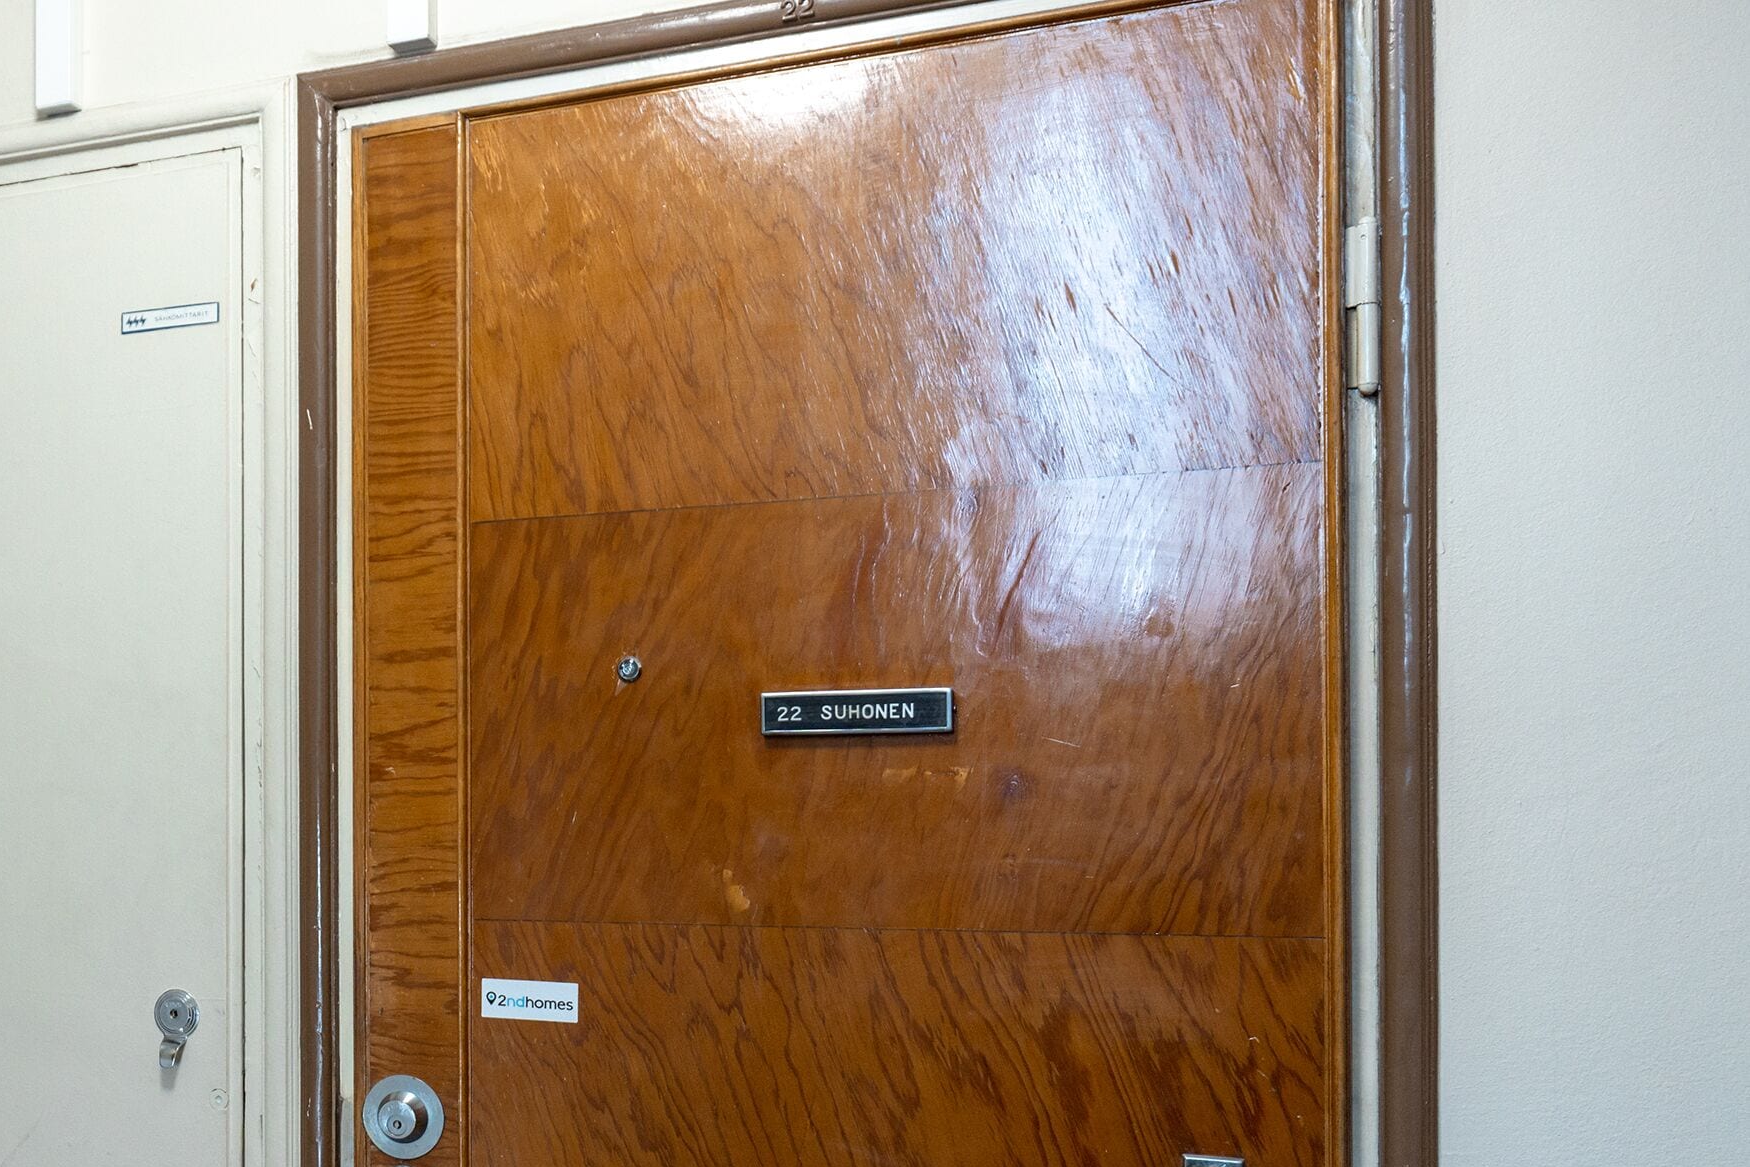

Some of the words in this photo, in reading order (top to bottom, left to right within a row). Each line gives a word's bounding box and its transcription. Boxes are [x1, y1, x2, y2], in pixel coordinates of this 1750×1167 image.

[780, 0, 815, 21] 22
[777, 706, 802, 721] 22
[820, 703, 915, 720] SUHONEN
[497, 994, 574, 1011] 2ndhomes
